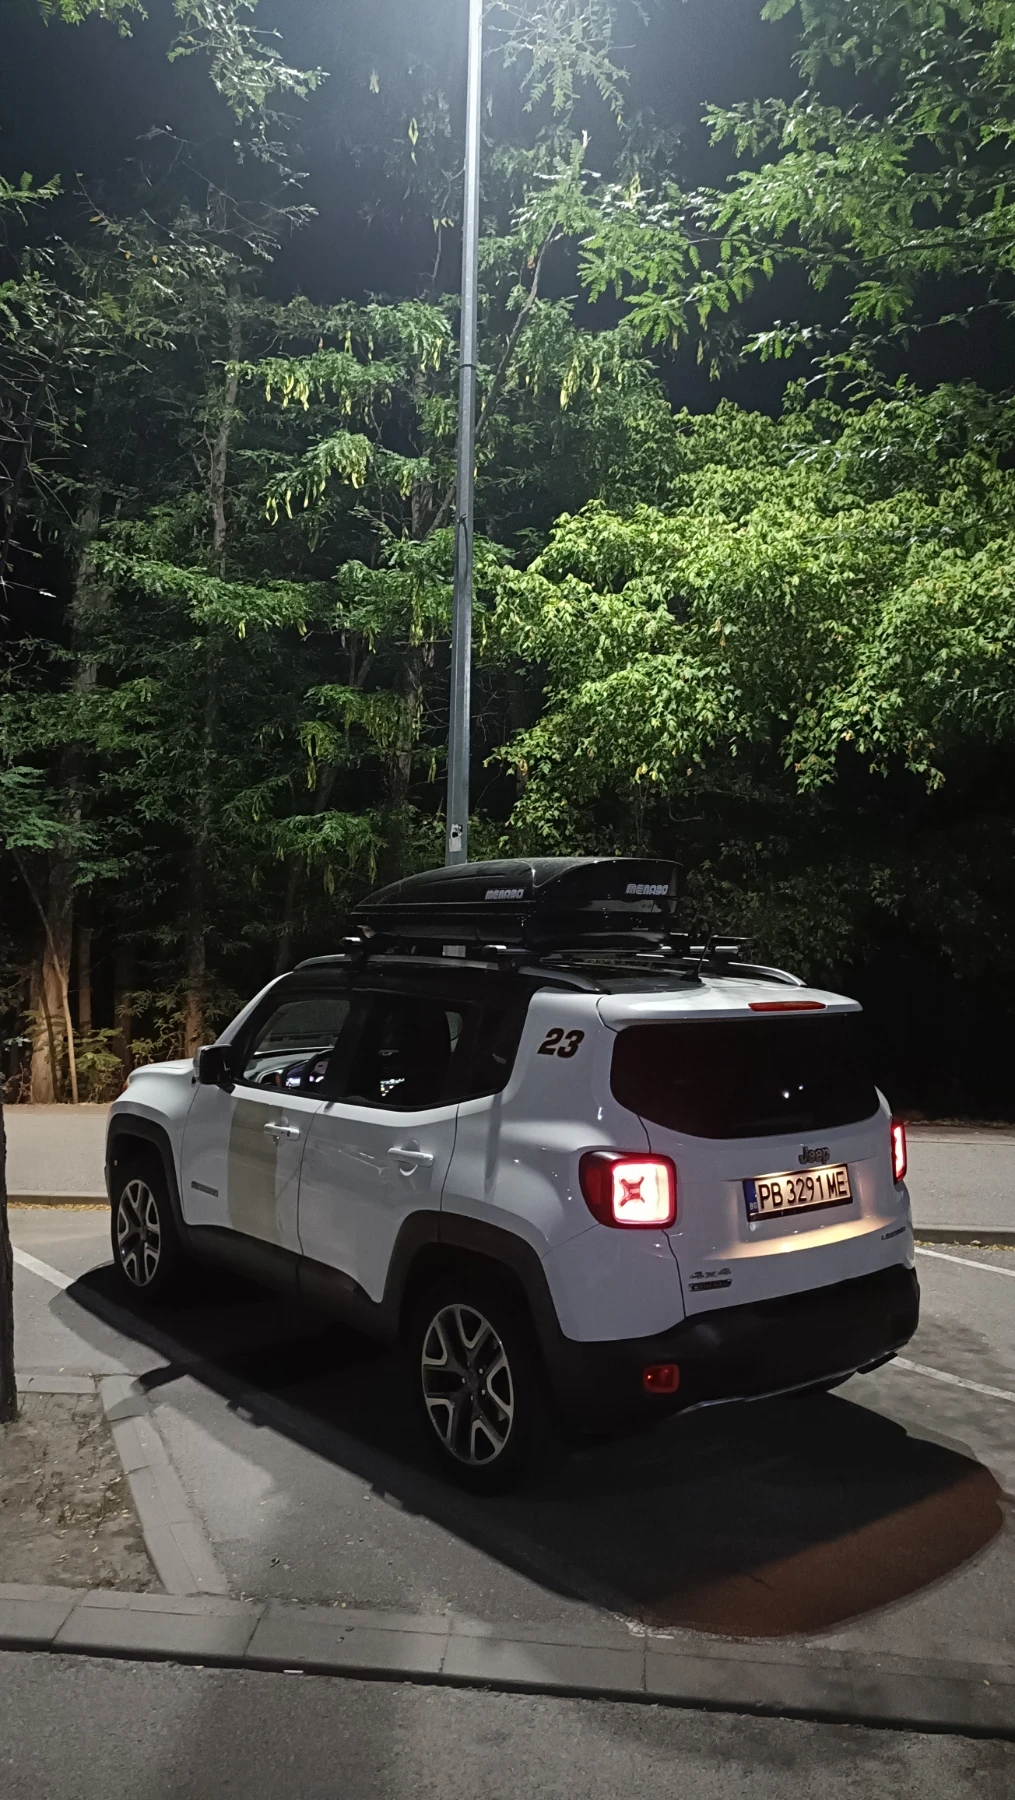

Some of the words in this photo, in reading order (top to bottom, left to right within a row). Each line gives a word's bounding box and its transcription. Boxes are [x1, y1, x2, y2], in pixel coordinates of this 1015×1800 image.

[626, 884, 669, 896] MENABO
[537, 1027, 585, 1059] 23
[798, 1146, 830, 1165] Jeep
[758, 1182, 783, 1210] PB
[787, 1176, 824, 1204] 3291
[826, 1171, 848, 1198] ME
